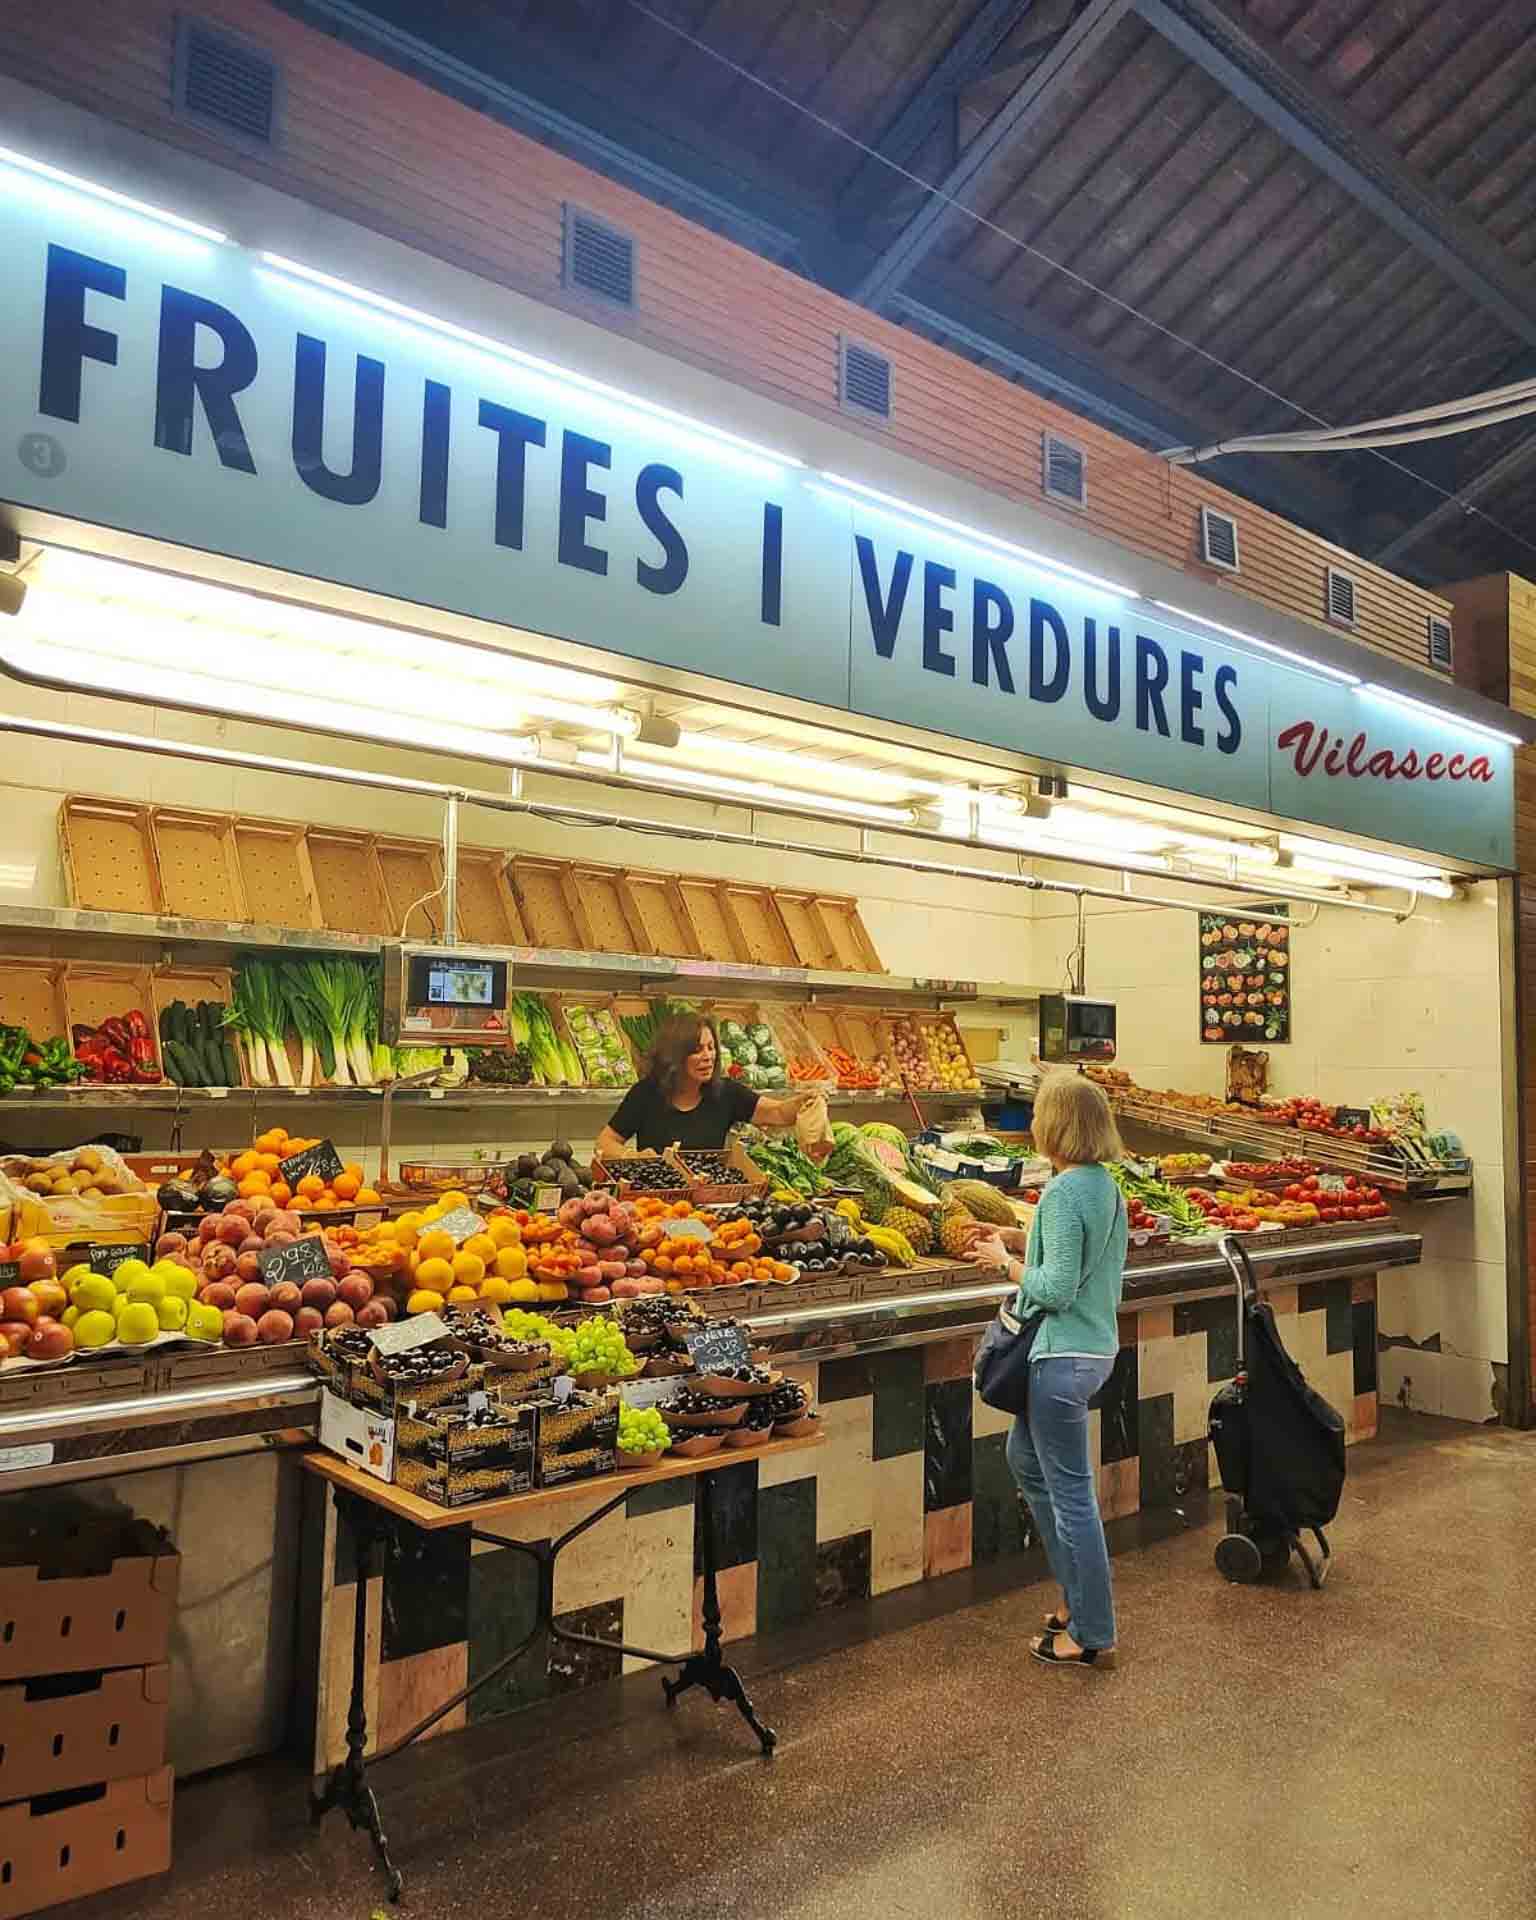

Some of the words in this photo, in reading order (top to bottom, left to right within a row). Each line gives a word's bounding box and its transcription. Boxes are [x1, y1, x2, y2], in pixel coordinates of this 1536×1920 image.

[39, 243, 689, 596] FRUITES
[761, 502, 783, 627] I
[855, 535, 1242, 755] VERDURES
[1278, 720, 1494, 784] Vilaseca
